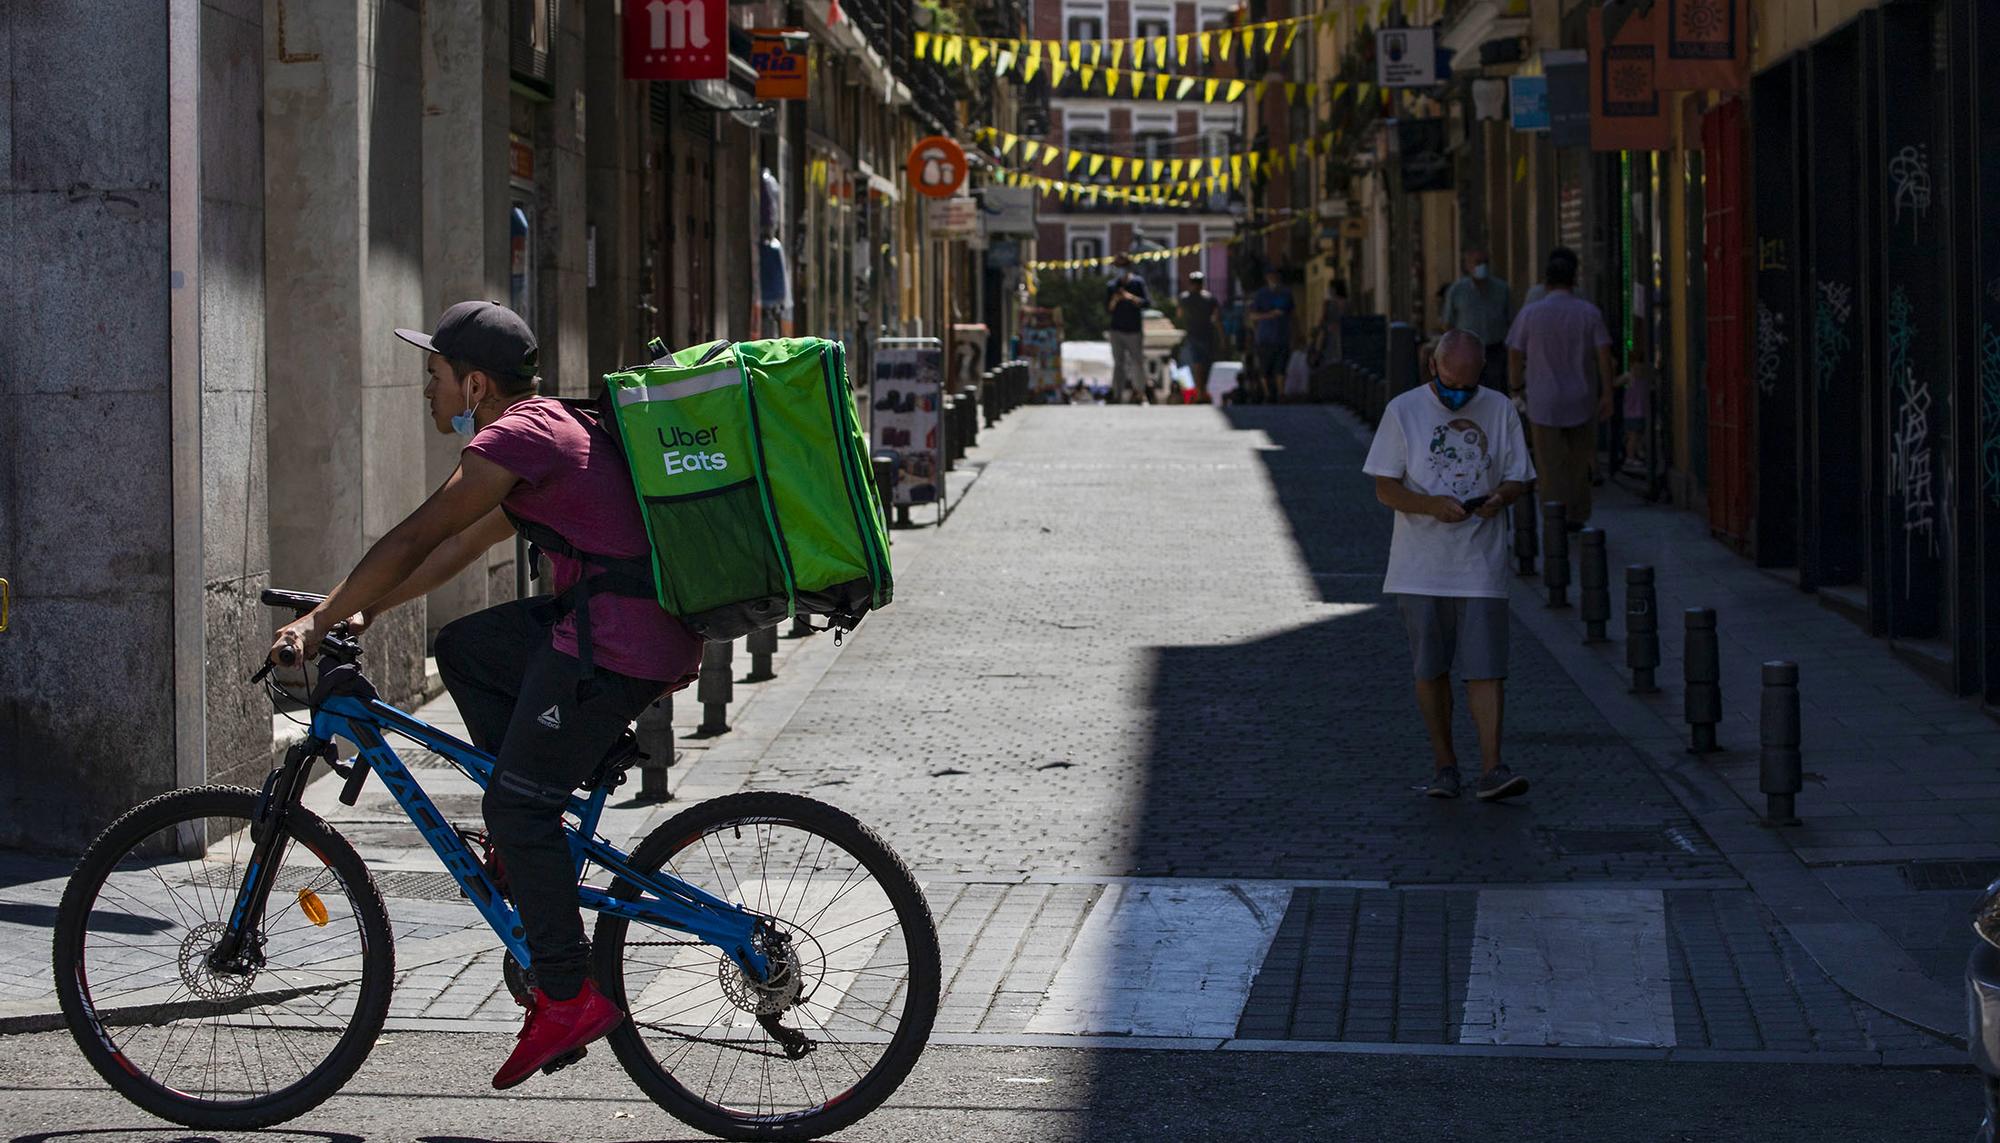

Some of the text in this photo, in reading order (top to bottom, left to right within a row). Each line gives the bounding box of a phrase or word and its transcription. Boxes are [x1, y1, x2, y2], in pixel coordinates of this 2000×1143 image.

[752, 47, 796, 71] Ria
[657, 426, 719, 448] Uber
[663, 450, 728, 476] Eats
[365, 745, 479, 880] RACER
